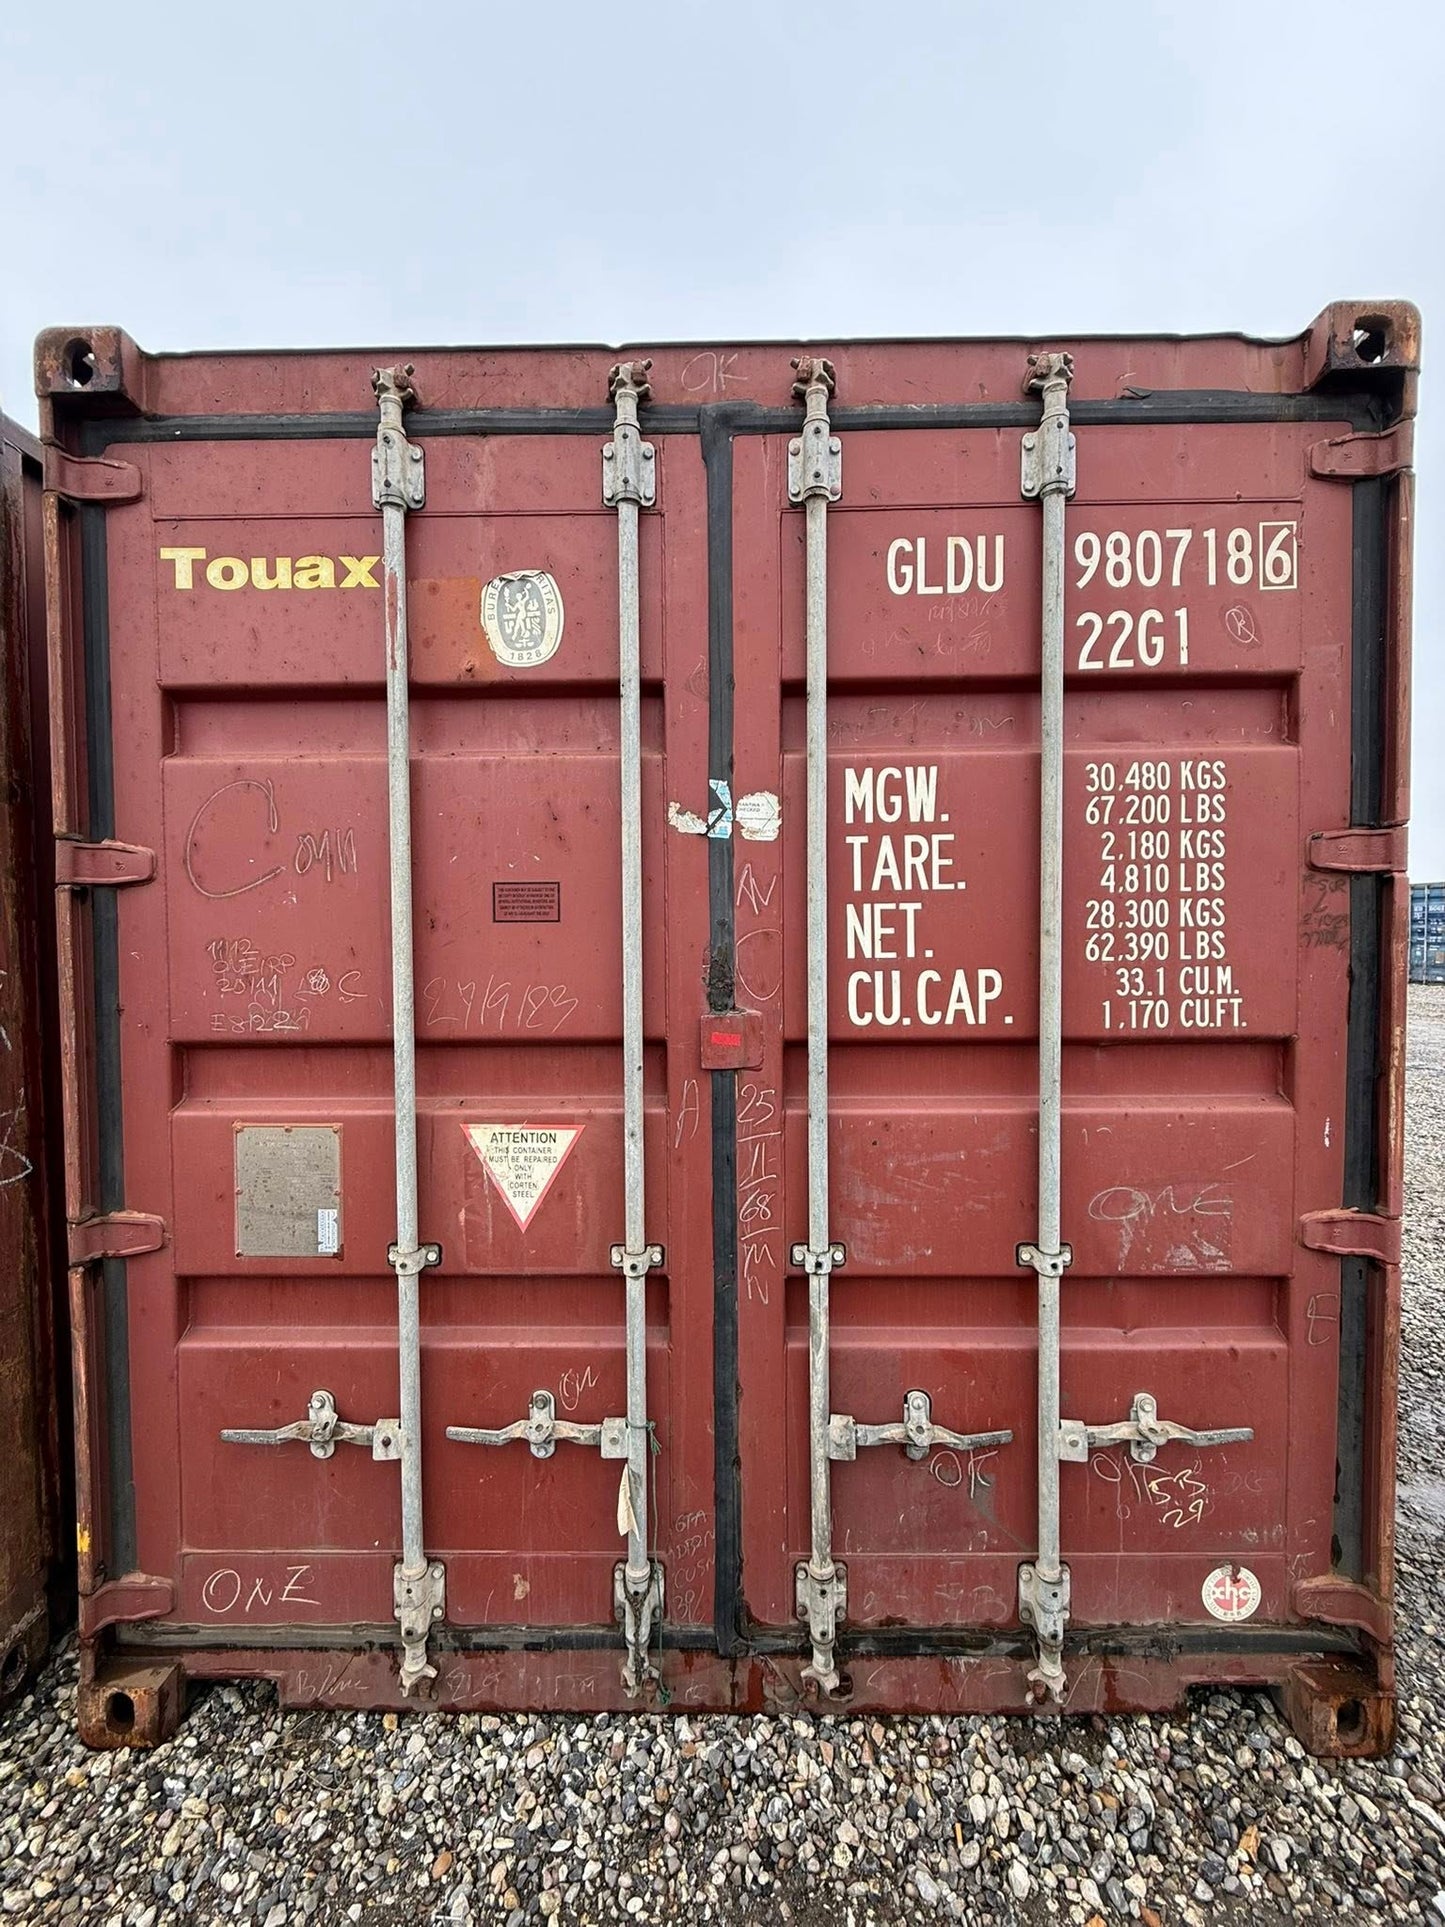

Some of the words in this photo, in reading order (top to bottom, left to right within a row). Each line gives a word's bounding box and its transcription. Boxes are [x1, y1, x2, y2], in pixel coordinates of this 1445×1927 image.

[160, 547, 381, 590] Touax
[886, 534, 1005, 596] GLDU
[1075, 607, 1189, 670] 22G1
[510, 650, 542, 661] 1828
[1085, 762, 1171, 792] 30,480
[1180, 760, 1226, 790] KGS
[844, 765, 949, 824] MGW.
[1085, 794, 1170, 825] 67,200
[1180, 793, 1226, 823] LBS
[1101, 830, 1170, 861] 2,180
[1180, 829, 1226, 859] KGS
[845, 834, 967, 891] TARE.
[1100, 863, 1169, 893] 4,810
[1180, 862, 1226, 892] LBS
[1085, 898, 1169, 929] 28,300
[1180, 898, 1226, 927] KGS
[846, 902, 934, 959] NET.
[1085, 931, 1169, 962] 62,390
[1180, 930, 1226, 960] LBS
[847, 968, 1013, 1026] CU.CAP.
[1115, 967, 1165, 997] 33.1
[1179, 965, 1240, 995] CU.M.
[1102, 999, 1169, 1029] 1,170
[1180, 998, 1247, 1028] CU.FT.
[490, 1132, 557, 1144] ATTENTION
[494, 1146, 510, 1154] THIS
[512, 1146, 552, 1154] CONTAINER
[488, 1155, 508, 1163] MUST
[511, 1155, 520, 1163] BE
[523, 1155, 558, 1163] REPAIRED
[514, 1164, 532, 1172] ONLY
[509, 1181, 538, 1189] CORTEN
[512, 1190, 534, 1198] STEEL
